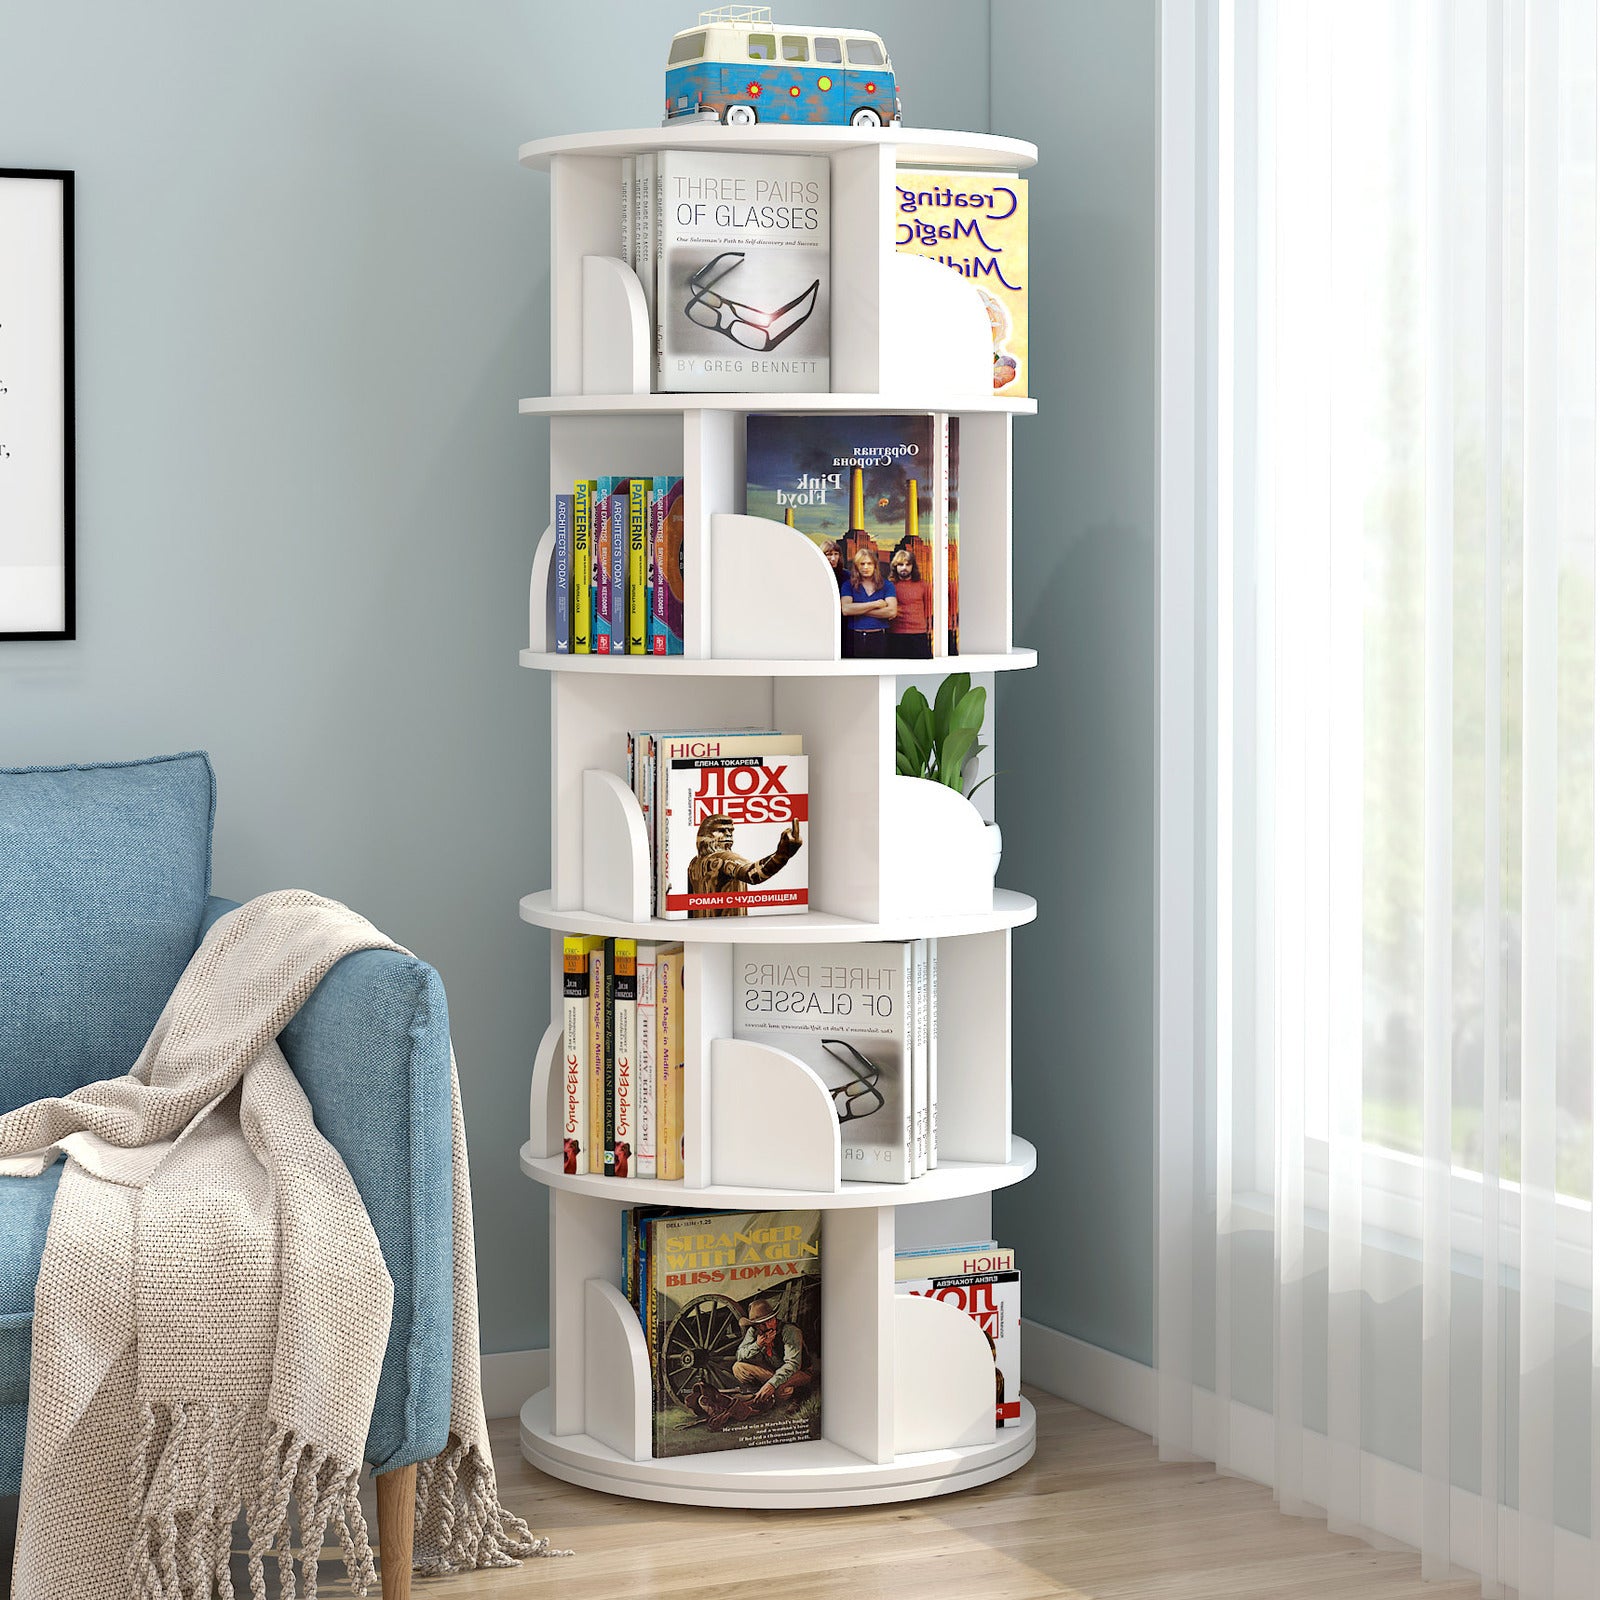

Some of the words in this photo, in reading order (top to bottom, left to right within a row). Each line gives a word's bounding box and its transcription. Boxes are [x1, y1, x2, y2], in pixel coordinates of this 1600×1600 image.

[672, 176, 746, 200] THREE
[756, 180, 819, 204] PAIRS
[677, 203, 706, 226] OF
[716, 204, 818, 230] GLASSES
[677, 360, 695, 371] BY
[704, 360, 742, 372] GREG
[752, 360, 816, 373] BENNETT
[576, 484, 586, 550] PATTERNS
[632, 484, 642, 550] PATTERNS
[558, 558, 566, 589] TODAY
[558, 640, 567, 648] K
[576, 636, 586, 644] K
[614, 641, 623, 649] K
[632, 637, 642, 645] K
[671, 743, 720, 758] HIGH
[695, 765, 788, 797] ЛОХ
[695, 796, 792, 826] NESS
[734, 893, 798, 903] ЧУДОВИЩЕМ
[566, 1054, 578, 1132] СуперСЕКС
[617, 1057, 629, 1136] СуперСЕКС
[666, 1226, 802, 1252] STRANGER
[666, 1250, 736, 1270] WITH
[742, 1247, 761, 1263] A
[765, 1240, 819, 1260] GUN
[666, 1270, 725, 1287] BLISS
[730, 1262, 798, 1280] LOMAX
